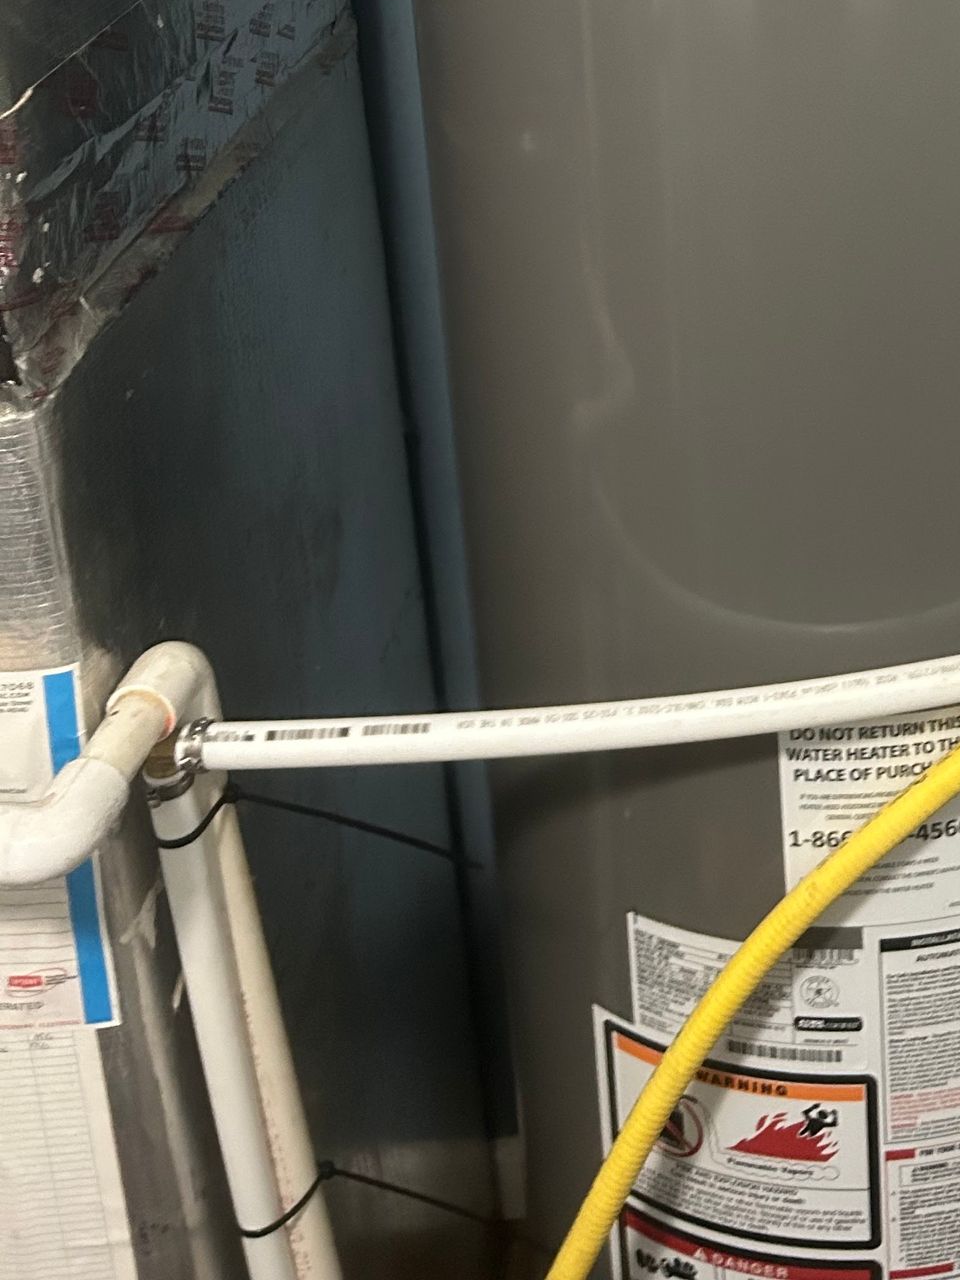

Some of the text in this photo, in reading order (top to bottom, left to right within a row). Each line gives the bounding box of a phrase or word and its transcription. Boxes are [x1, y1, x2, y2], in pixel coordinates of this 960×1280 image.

[789, 728, 815, 740] DO
[818, 727, 854, 740] NOT
[858, 721, 925, 739] RETURN
[786, 748, 844, 761] WATER
[846, 744, 911, 760] HEATER
[912, 740, 935, 756] TO
[793, 769, 848, 782] PLACE
[850, 768, 873, 781] OF
[696, 1069, 788, 1096] WARNING
[712, 1252, 788, 1279] DANGER
